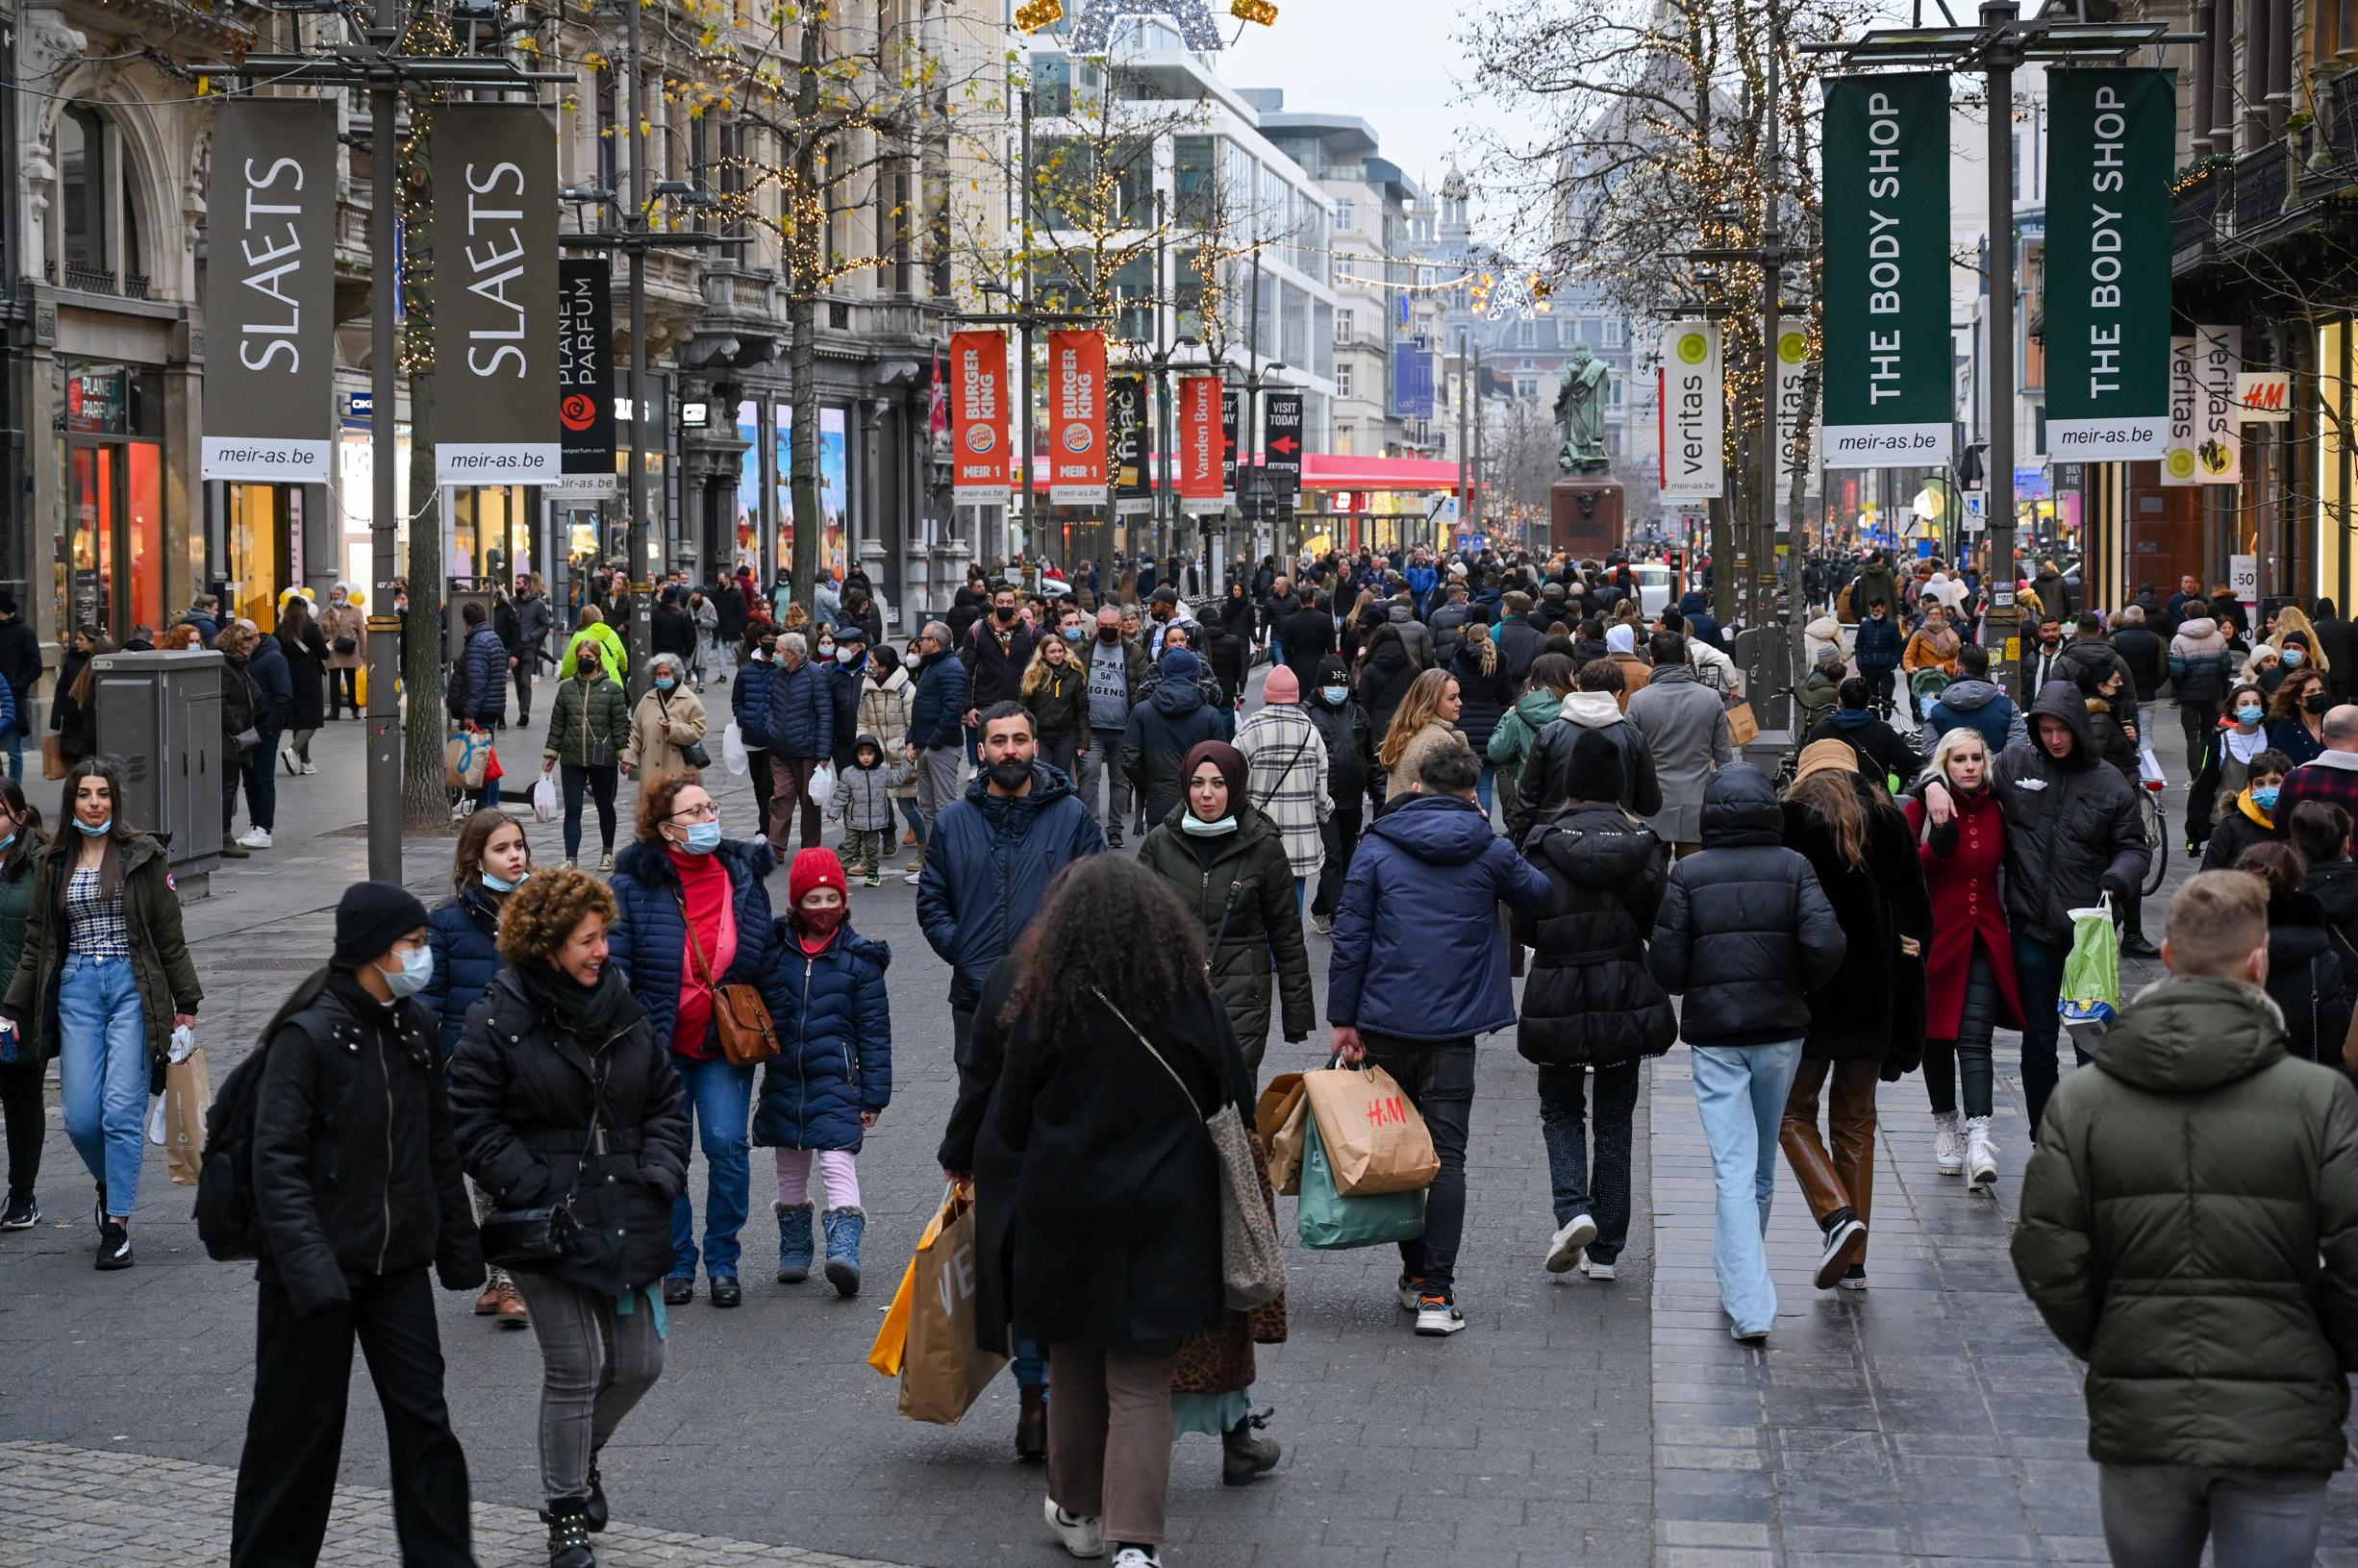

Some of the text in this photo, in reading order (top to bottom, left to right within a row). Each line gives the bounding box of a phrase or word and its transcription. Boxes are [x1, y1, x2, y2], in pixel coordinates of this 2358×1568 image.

[1869, 92, 1901, 406] THE BODY SHOP
[2092, 87, 2126, 399] THE BODY SHOP
[239, 158, 304, 374] SLAETS
[465, 162, 526, 379] SLAETS
[574, 278, 597, 385] PARFUM
[964, 349, 981, 420] BURGER
[979, 374, 995, 419] KING
[1062, 349, 1078, 419] BURGER
[1077, 373, 1093, 419] KING
[2173, 343, 2196, 438] veritas
[2208, 333, 2234, 434] veritas
[2243, 383, 2286, 411] H&M
[1194, 382, 1209, 422] Borre
[1273, 402, 1297, 413] VISIT
[1116, 391, 1138, 460] fnac
[1269, 414, 1299, 426] TODAY
[1678, 375, 1703, 475] veritas
[2062, 426, 2153, 445] meir-as.be
[219, 447, 314, 464] meir-as.be
[1194, 425, 1209, 481] Vanden
[1839, 432, 1936, 451] meir-as.be
[451, 452, 544, 468] meir-as.be
[963, 465, 1001, 479] MEIR 1
[1060, 464, 1097, 478] MEIR 1
[961, 488, 1004, 498] meir-as.be
[1057, 488, 1100, 497] meir-as.be
[1671, 482, 1716, 490] meir-as.be
[1089, 685, 1125, 698] EGEND
[1100, 672, 1112, 681] 58
[1332, 670, 1346, 682] NY
